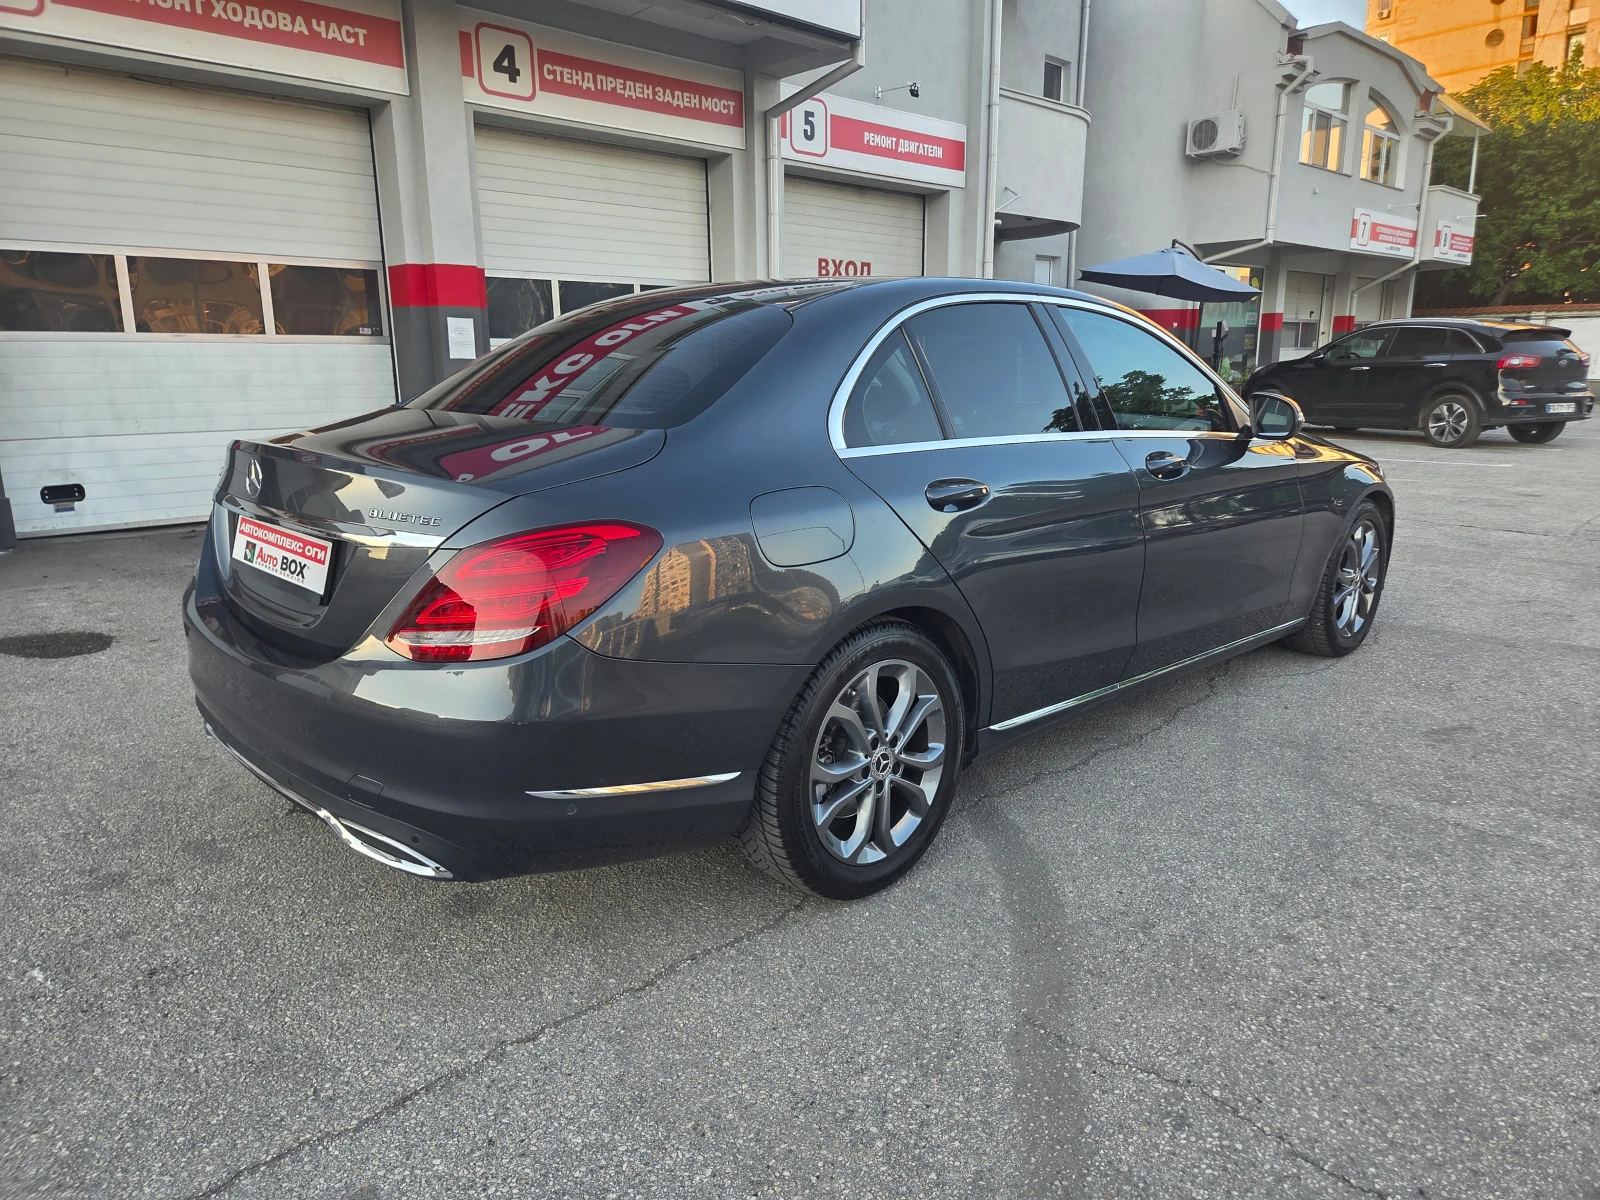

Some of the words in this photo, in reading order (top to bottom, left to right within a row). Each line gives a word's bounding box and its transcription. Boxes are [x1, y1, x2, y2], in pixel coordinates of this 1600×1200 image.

[211, 0, 309, 35] ХОДОВА
[311, 18, 368, 46] ЧАСТ
[492, 44, 521, 84] 4
[543, 63, 595, 91] СТЕНД
[597, 74, 652, 100] ПРЕДЕН
[655, 86, 699, 109] ЗАДЕН
[701, 96, 736, 115] МОСТ
[803, 110, 815, 142] 5
[864, 131, 897, 150] РЕМОНТ
[898, 138, 943, 159] ДВИГАТЕЛИ
[1361, 221, 1367, 239] 7
[368, 508, 442, 526] BLUETEC
[240, 522, 304, 553] АВТОКОМПЛЕКС
[304, 545, 326, 561] ОГИ
[254, 560, 278, 573] EXPRESS
[279, 570, 305, 584] SERVICE
[280, 555, 307, 579] BOX
